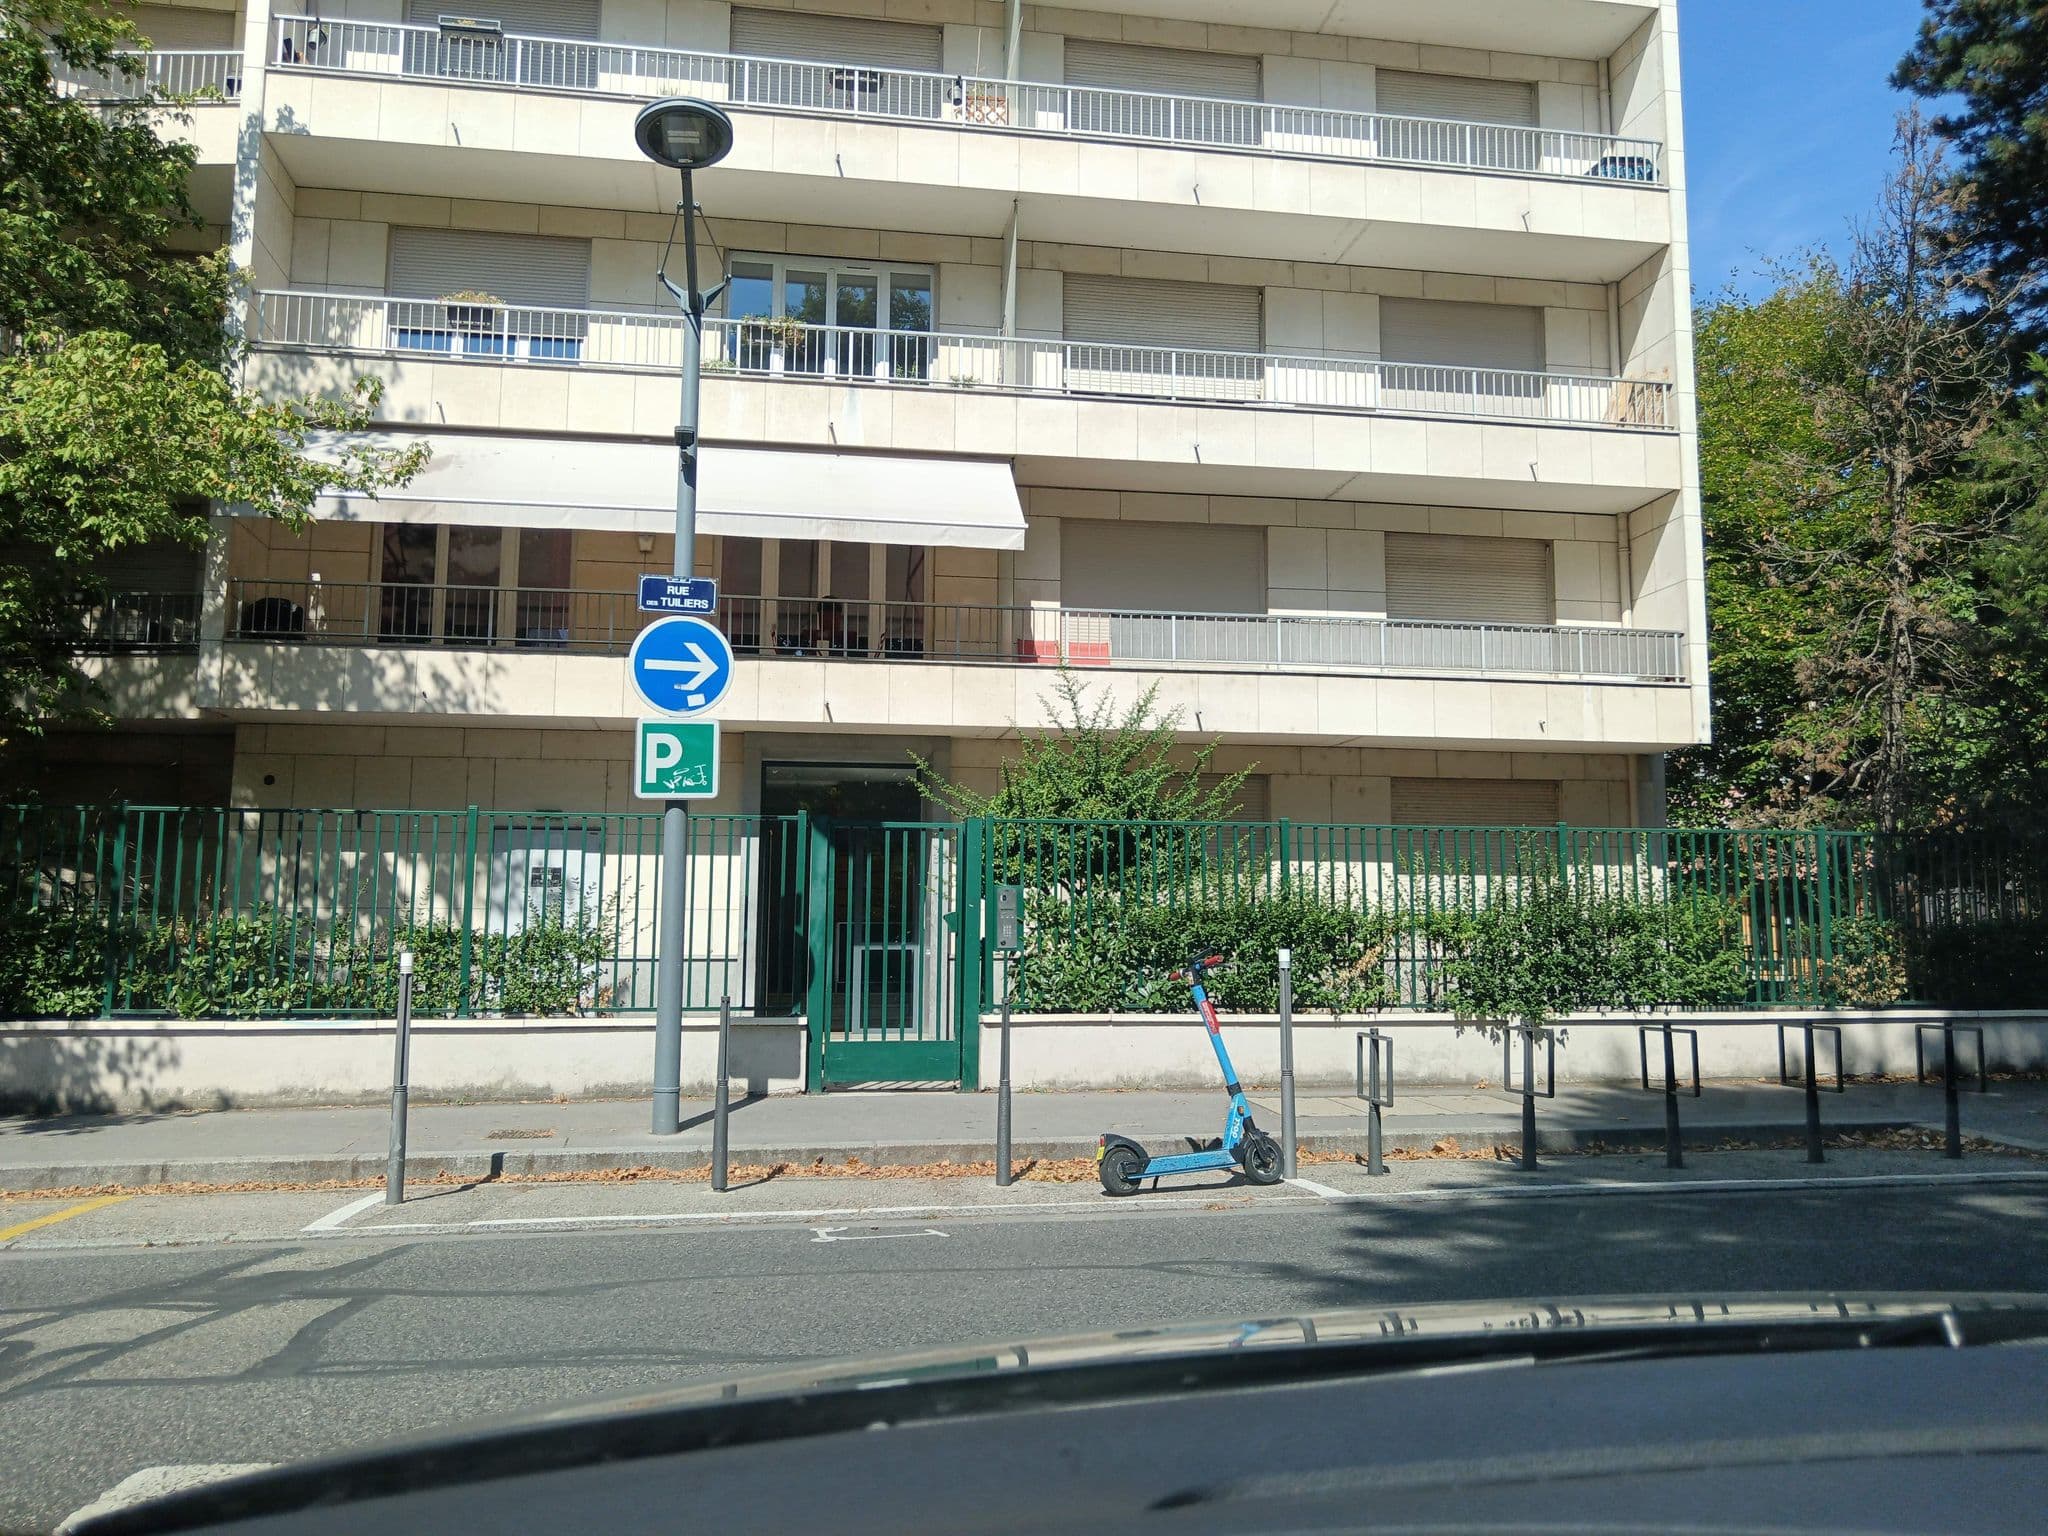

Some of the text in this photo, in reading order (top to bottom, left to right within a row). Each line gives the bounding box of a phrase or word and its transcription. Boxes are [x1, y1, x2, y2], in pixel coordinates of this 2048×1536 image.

[667, 585, 690, 595] RUE
[660, 597, 709, 609] TUILIERS
[645, 733, 683, 784] P
